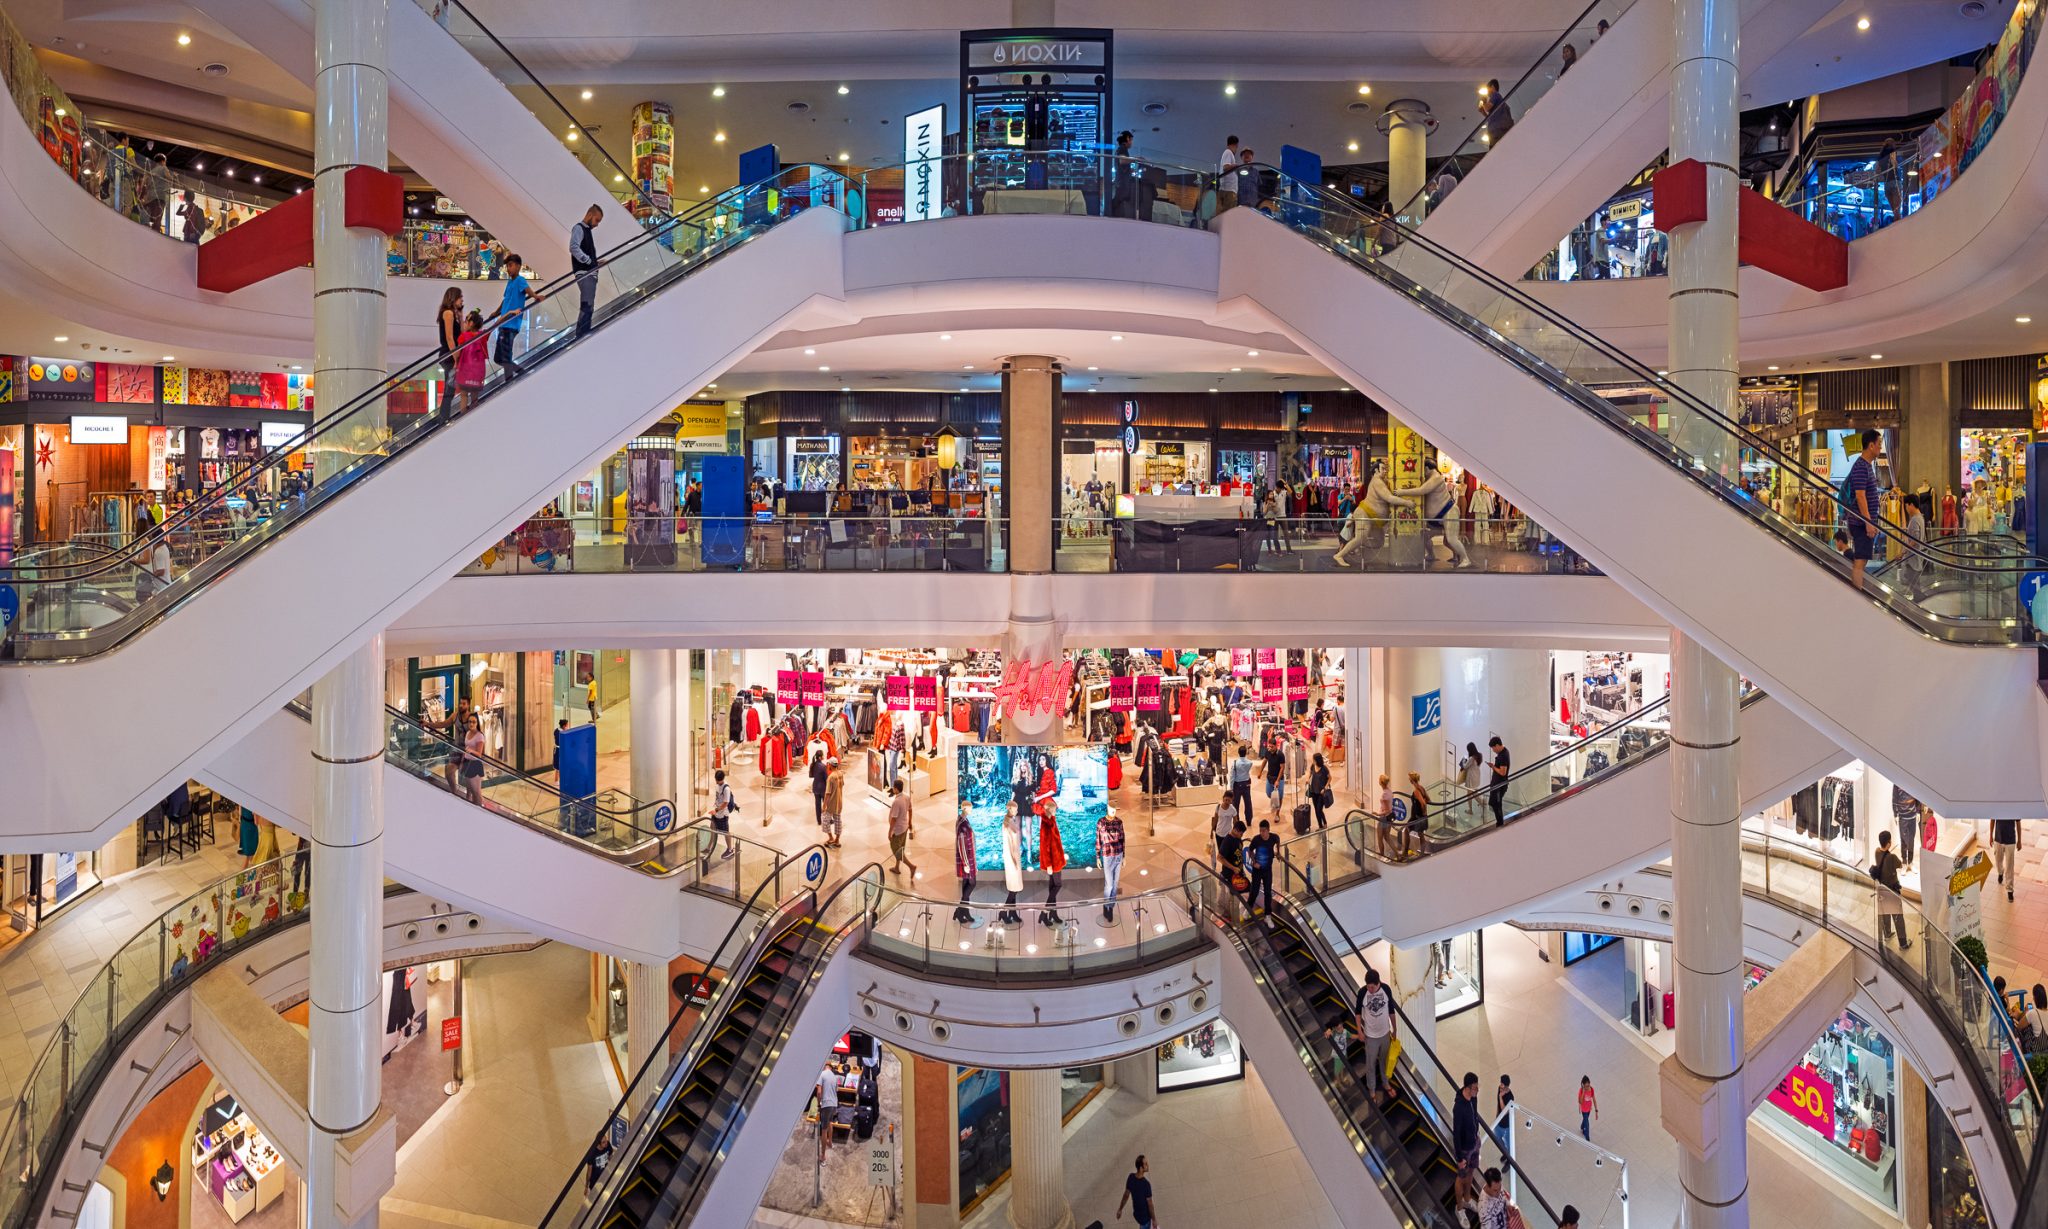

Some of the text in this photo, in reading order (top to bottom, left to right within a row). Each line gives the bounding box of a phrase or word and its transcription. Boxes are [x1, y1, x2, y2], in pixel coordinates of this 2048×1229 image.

[687, 416, 720, 425] OPEN DAILY
[1812, 457, 1828, 466] SALE
[1233, 664, 1252, 672] FREE
[992, 659, 1074, 720] H&M
[1263, 688, 1282, 697] FREE
[1288, 686, 1308, 696] FREE
[778, 690, 798, 700] FREE
[803, 692, 823, 701] FREE
[888, 696, 909, 706] FREE
[914, 697, 936, 706] FREE
[1112, 698, 1132, 706] FREE
[1138, 696, 1160, 704] FREE
[810, 857, 819, 873] M
[444, 1029, 459, 1038] SALE
[872, 1150, 890, 1159] 3000
